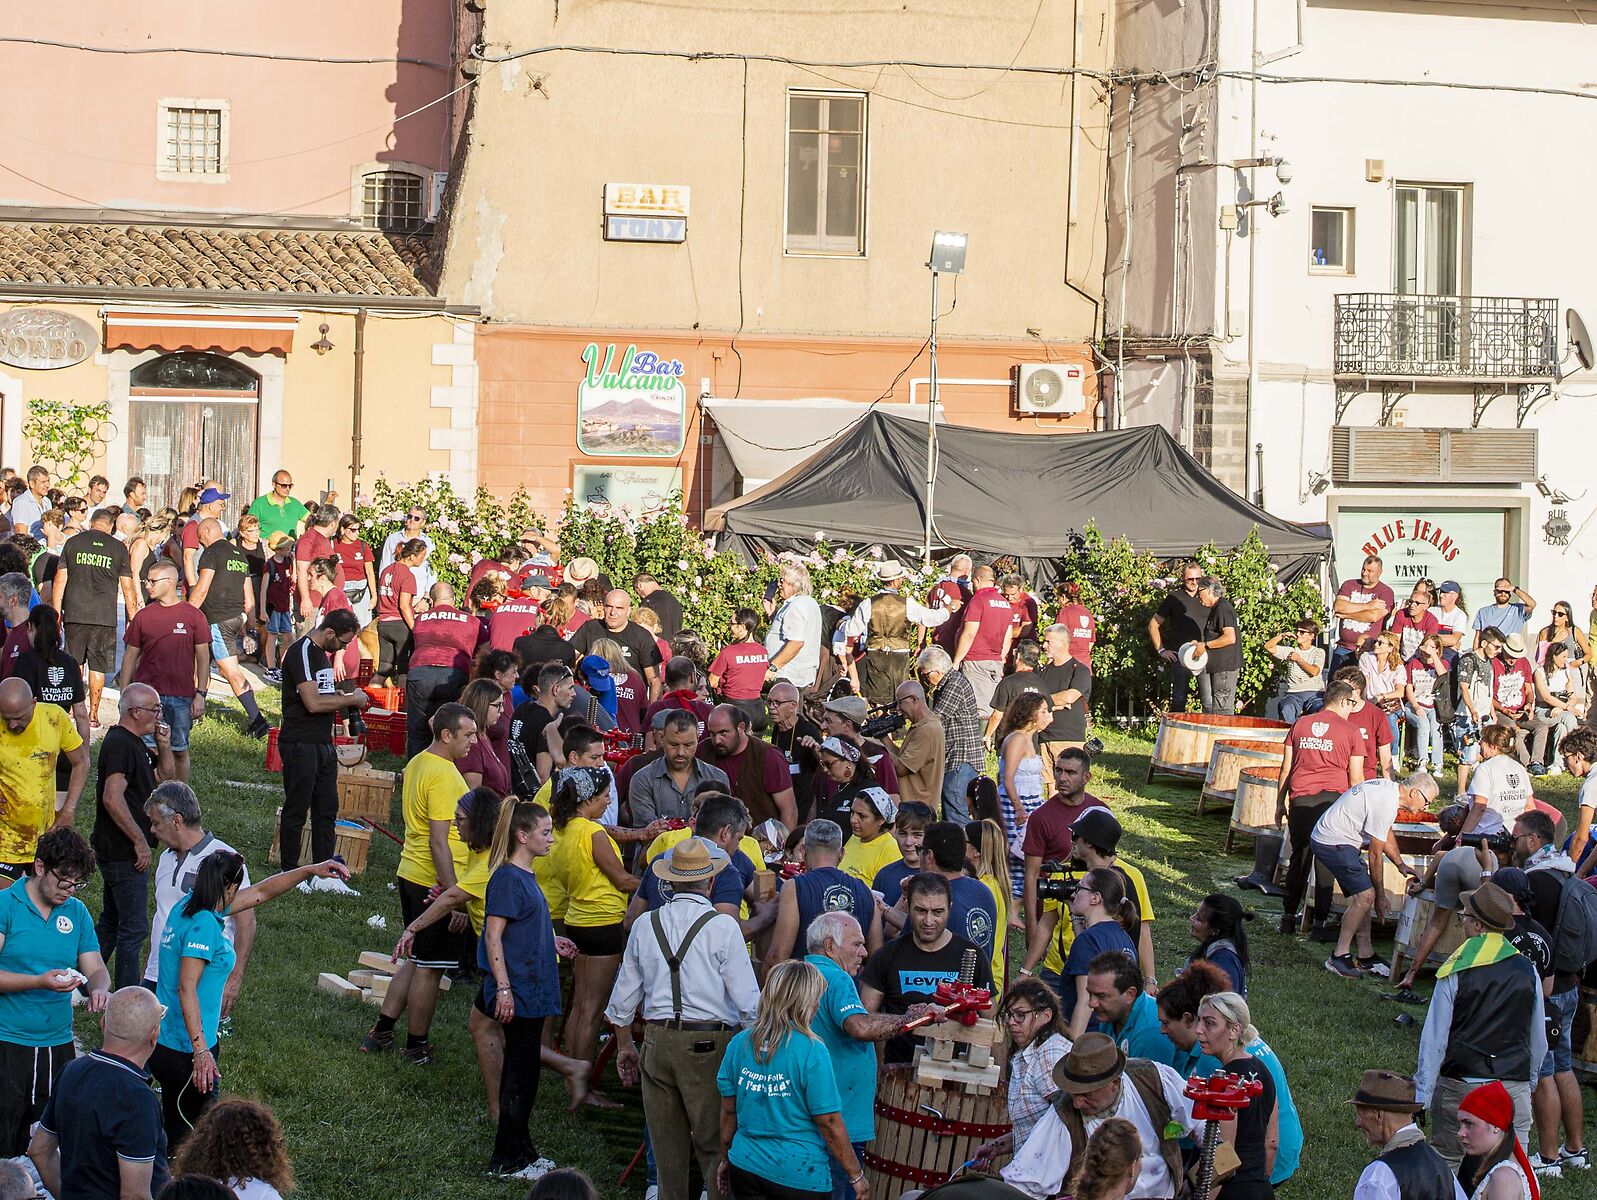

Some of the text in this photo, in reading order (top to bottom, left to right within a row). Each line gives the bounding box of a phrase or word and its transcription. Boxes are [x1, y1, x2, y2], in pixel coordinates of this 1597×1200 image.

[617, 187, 681, 205] BAR
[610, 218, 685, 239] TONY
[581, 343, 677, 391] Vulcano
[630, 351, 684, 377] Bar
[1548, 509, 1568, 521] BLUE
[1361, 518, 1460, 562] BLUE JEANS
[1542, 534, 1569, 546] JEANS
[1406, 547, 1415, 557] by
[76, 552, 113, 570] CASCATE
[1395, 564, 1428, 578] VANNI
[497, 604, 538, 615] BARILE
[420, 611, 469, 624] BARILE
[1299, 741, 1333, 752] TORCHIO
[187, 941, 210, 951] LAURA
[767, 1072, 784, 1082] Folk
